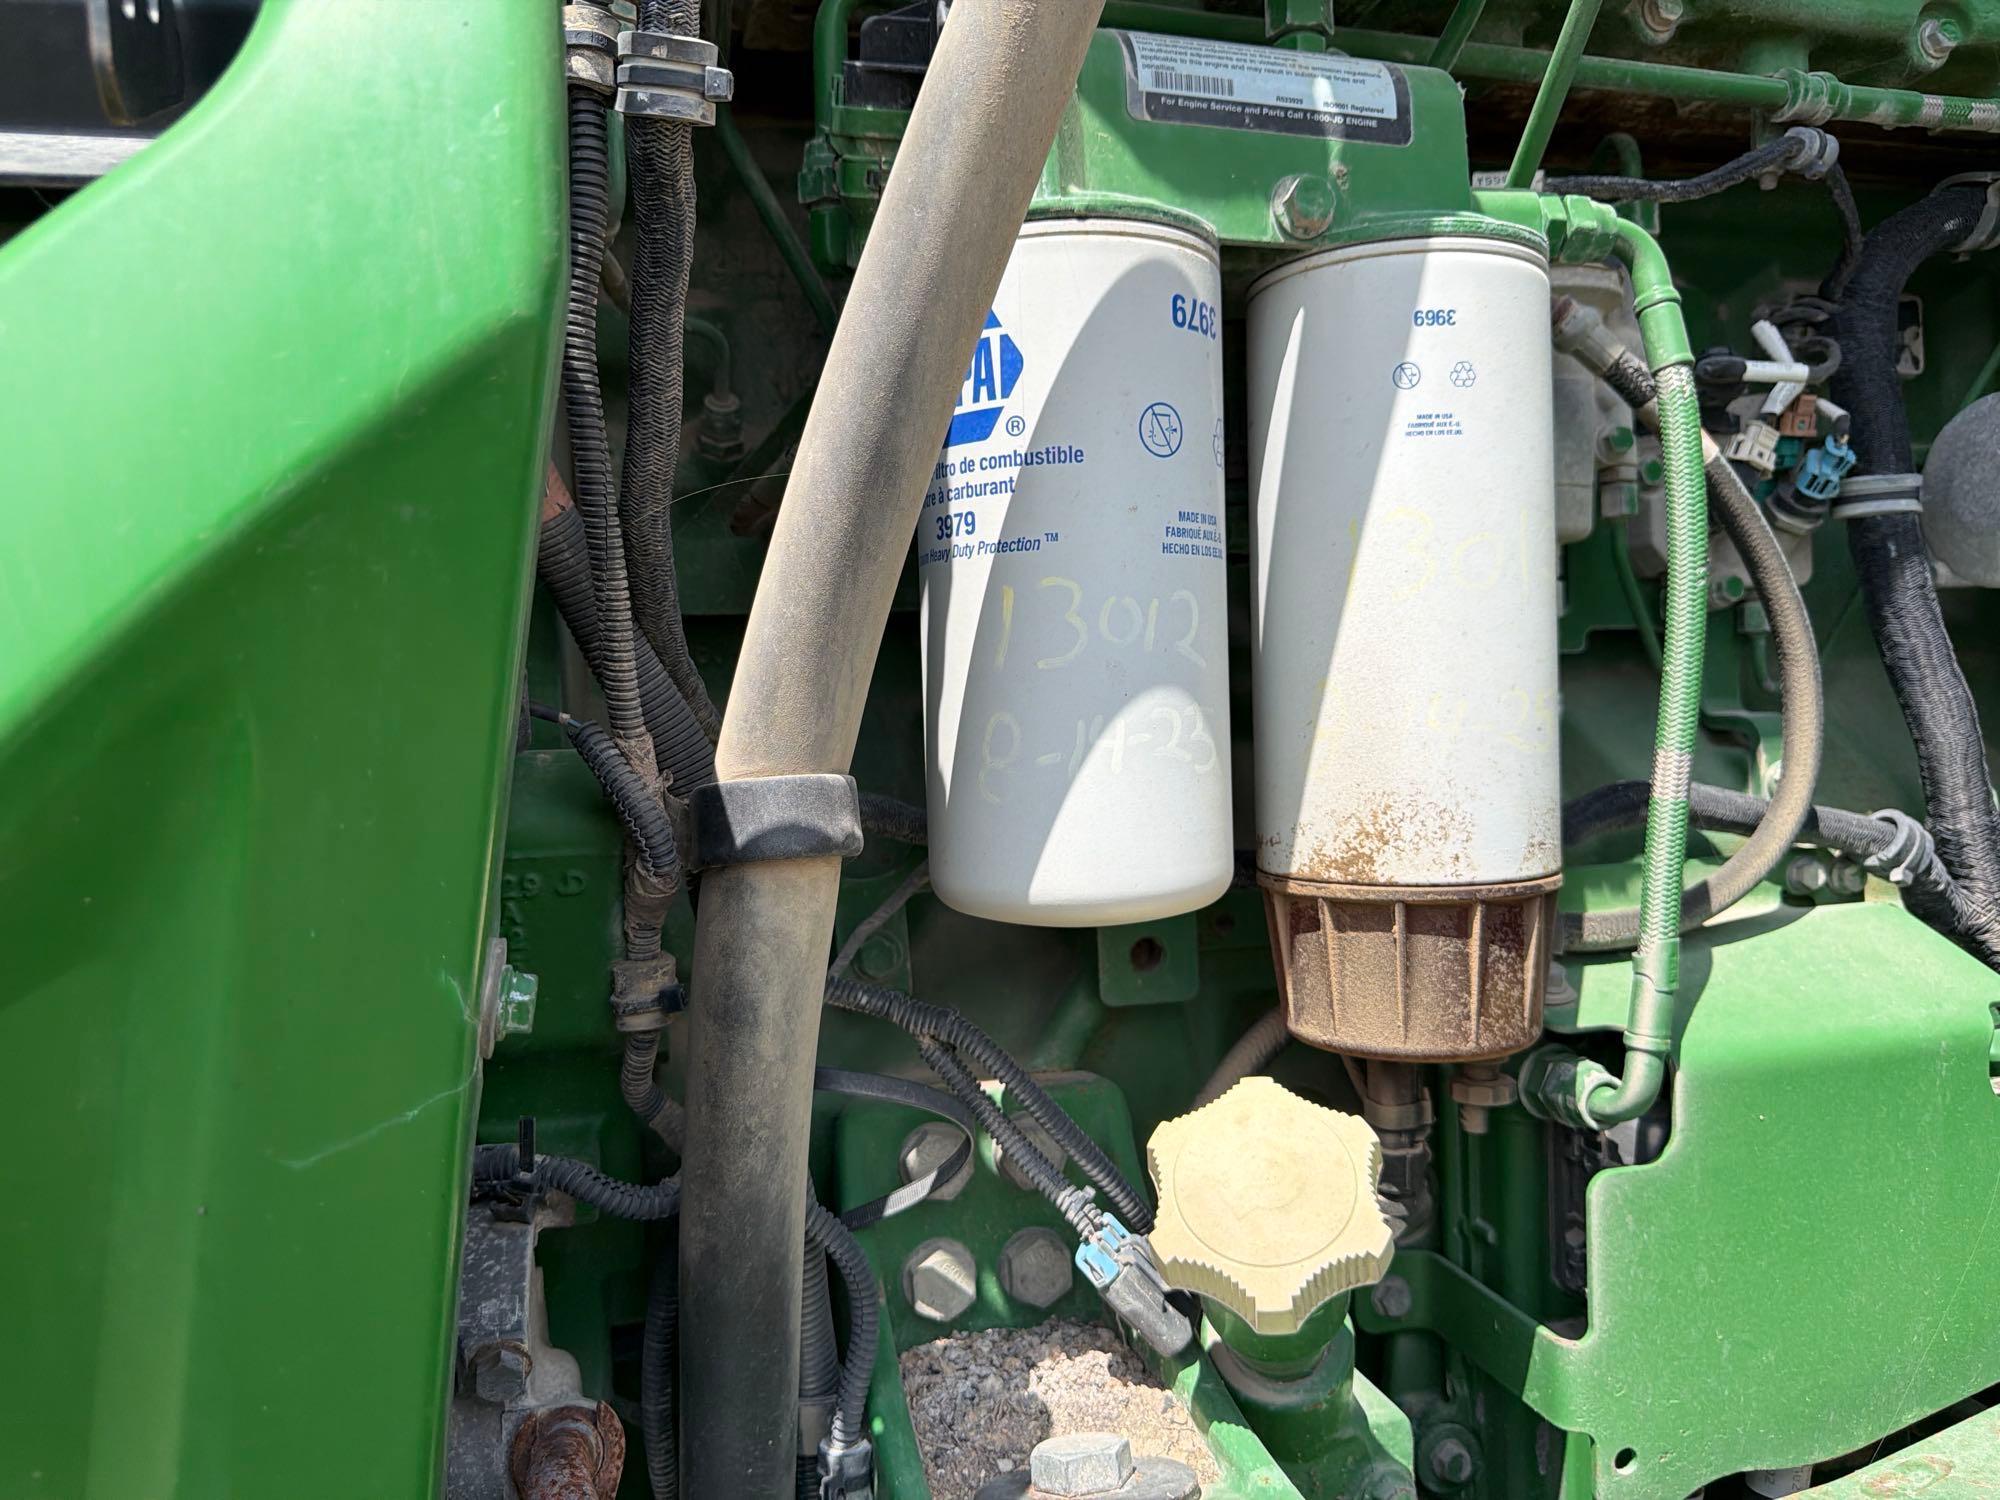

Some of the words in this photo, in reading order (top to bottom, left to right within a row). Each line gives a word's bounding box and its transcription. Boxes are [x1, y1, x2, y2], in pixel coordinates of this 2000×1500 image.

[1160, 97, 1175, 106] For
[1178, 98, 1208, 110] Engine
[1210, 100, 1242, 114] Service
[1244, 105, 1260, 116] and
[1262, 107, 1286, 118] Parts
[1287, 110, 1304, 120] Call
[1306, 112, 1344, 125] 1-800-JD
[1346, 116, 1378, 128] ENGINE
[1413, 309, 1457, 327] 3969
[929, 462, 956, 481] iltro
[960, 456, 976, 475] de
[979, 445, 1084, 472] combustible
[938, 486, 945, 504] à
[946, 476, 1016, 502] carburant
[936, 510, 976, 541] 3979
[1178, 510, 1200, 524] MADE
[1200, 513, 1207, 524] IN
[1165, 526, 1202, 540] FABRIQUÉ
[1202, 529, 1214, 541] AUX
[929, 548, 951, 564] Heavy
[952, 542, 976, 560] Duty
[977, 536, 1041, 556] Protection
[1162, 542, 1190, 555] HECHO
[1191, 544, 1200, 556] EN
[1201, 545, 1212, 557] LOS
[994, 575, 1207, 670] 13012
